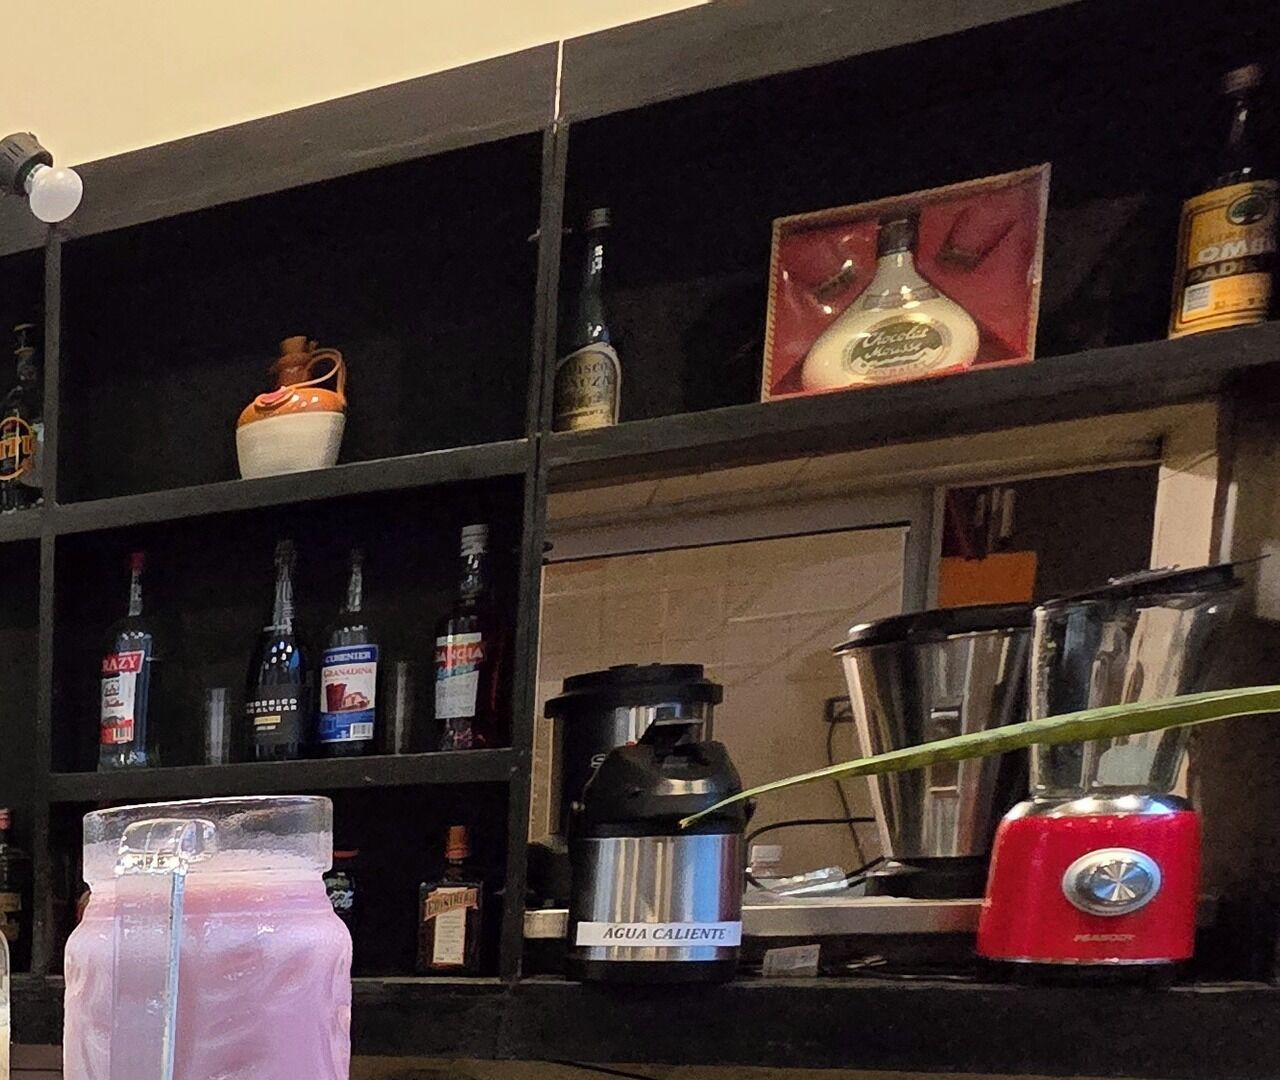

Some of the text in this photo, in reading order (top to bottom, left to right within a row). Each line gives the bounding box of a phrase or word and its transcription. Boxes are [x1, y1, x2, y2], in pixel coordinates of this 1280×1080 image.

[101, 655, 140, 672] RAZY
[603, 927, 727, 940] AGUA CALIENTE
